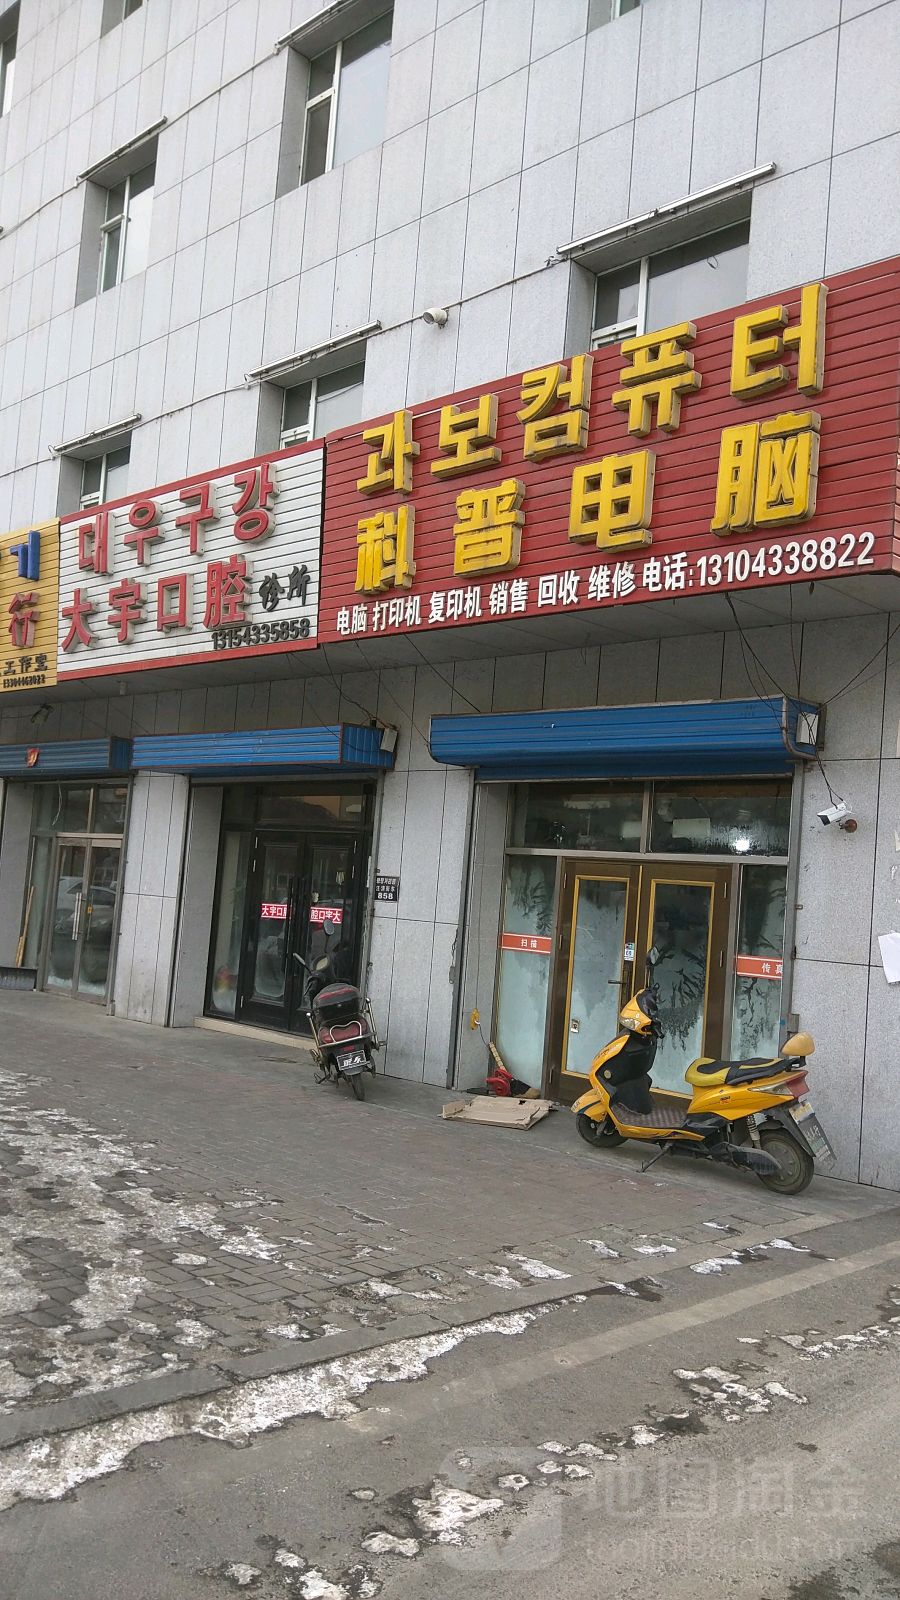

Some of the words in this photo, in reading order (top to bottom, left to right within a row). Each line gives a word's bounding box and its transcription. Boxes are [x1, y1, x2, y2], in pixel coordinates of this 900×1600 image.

[355, 282, 829, 496] 과보컴퓨터
[78, 462, 280, 577] 대우구강
[353, 410, 822, 596] 科普电脑
[61, 553, 254, 653] 大宇口腔
[258, 564, 311, 612] 诊所
[211, 618, 311, 651] 13154335858
[336, 602, 368, 637] 电脑
[372, 596, 422, 632] 打印机
[428, 585, 482, 623] 复印机
[489, 578, 529, 615] 销售
[537, 570, 580, 608] 回收
[587, 561, 636, 601] 维修
[377, 892, 394, 900] 858
